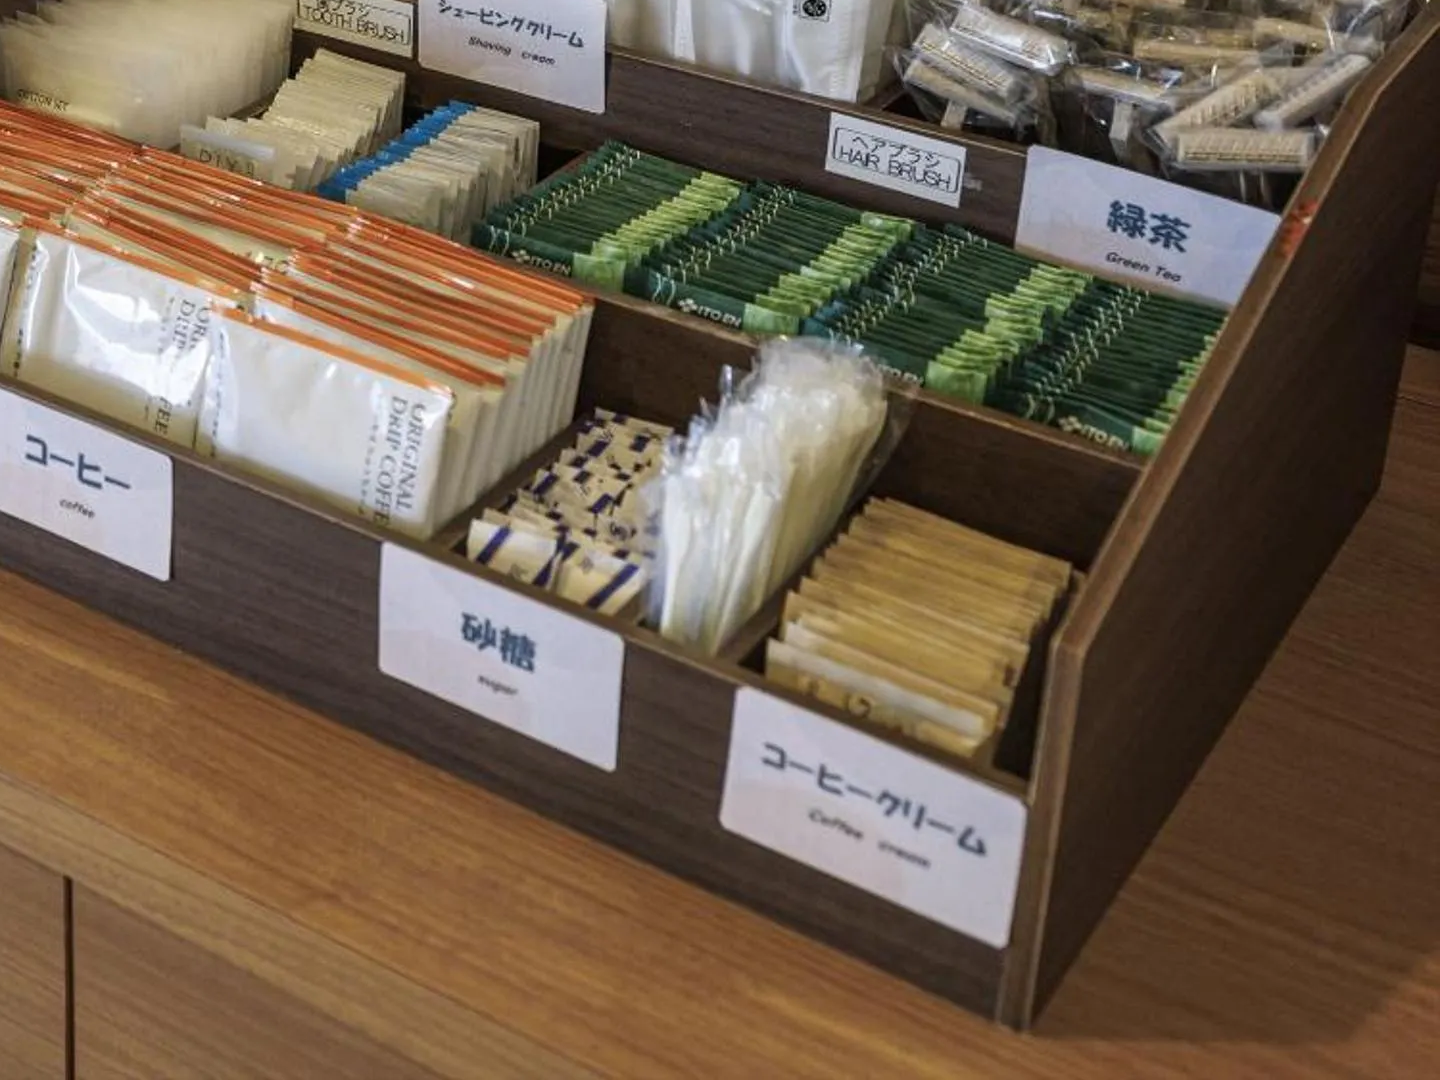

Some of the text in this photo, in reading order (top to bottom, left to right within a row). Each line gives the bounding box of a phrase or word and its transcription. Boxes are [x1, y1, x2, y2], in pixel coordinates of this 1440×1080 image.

[303, 5, 405, 42] TOOTH BRUSH
[468, 36, 512, 57] Shaving
[839, 146, 952, 190] HAIR BRUSH
[852, 136, 940, 168] ヘアブラシ
[1106, 200, 1191, 253] 緑茶
[1105, 251, 1182, 282] Green Tea
[24, 433, 132, 490] コーヒー
[373, 395, 409, 528] DRIP COFFE
[394, 402, 427, 511] ORIGINAL
[59, 498, 95, 519] coffee
[461, 611, 537, 673] 砂糖
[760, 741, 988, 857] コーヒークリーム
